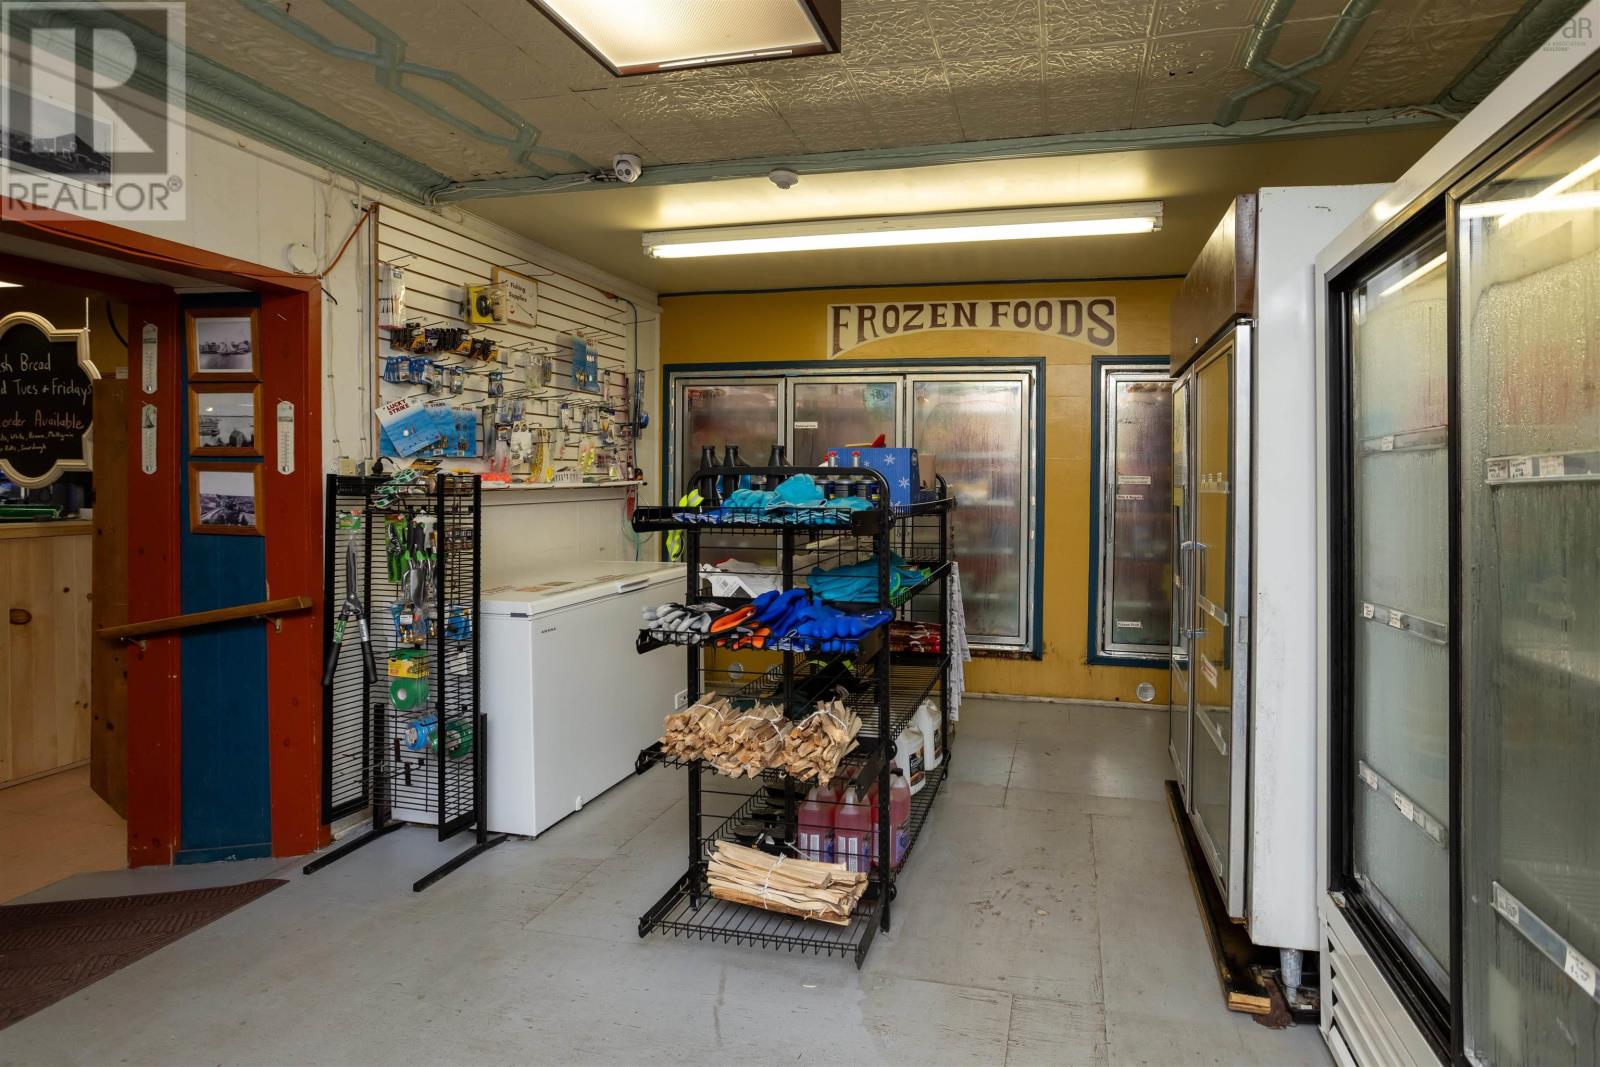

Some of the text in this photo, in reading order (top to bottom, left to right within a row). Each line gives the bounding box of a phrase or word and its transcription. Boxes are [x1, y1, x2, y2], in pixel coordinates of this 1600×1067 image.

[832, 299, 1115, 355] FROZEN FOODS
[20, 352, 51, 372] Bread
[12, 378, 39, 395] Tues
[52, 377, 92, 405] Fridays
[386, 398, 406, 411] LUCKY
[388, 403, 410, 415] STRIKE
[34, 409, 84, 430] Available
